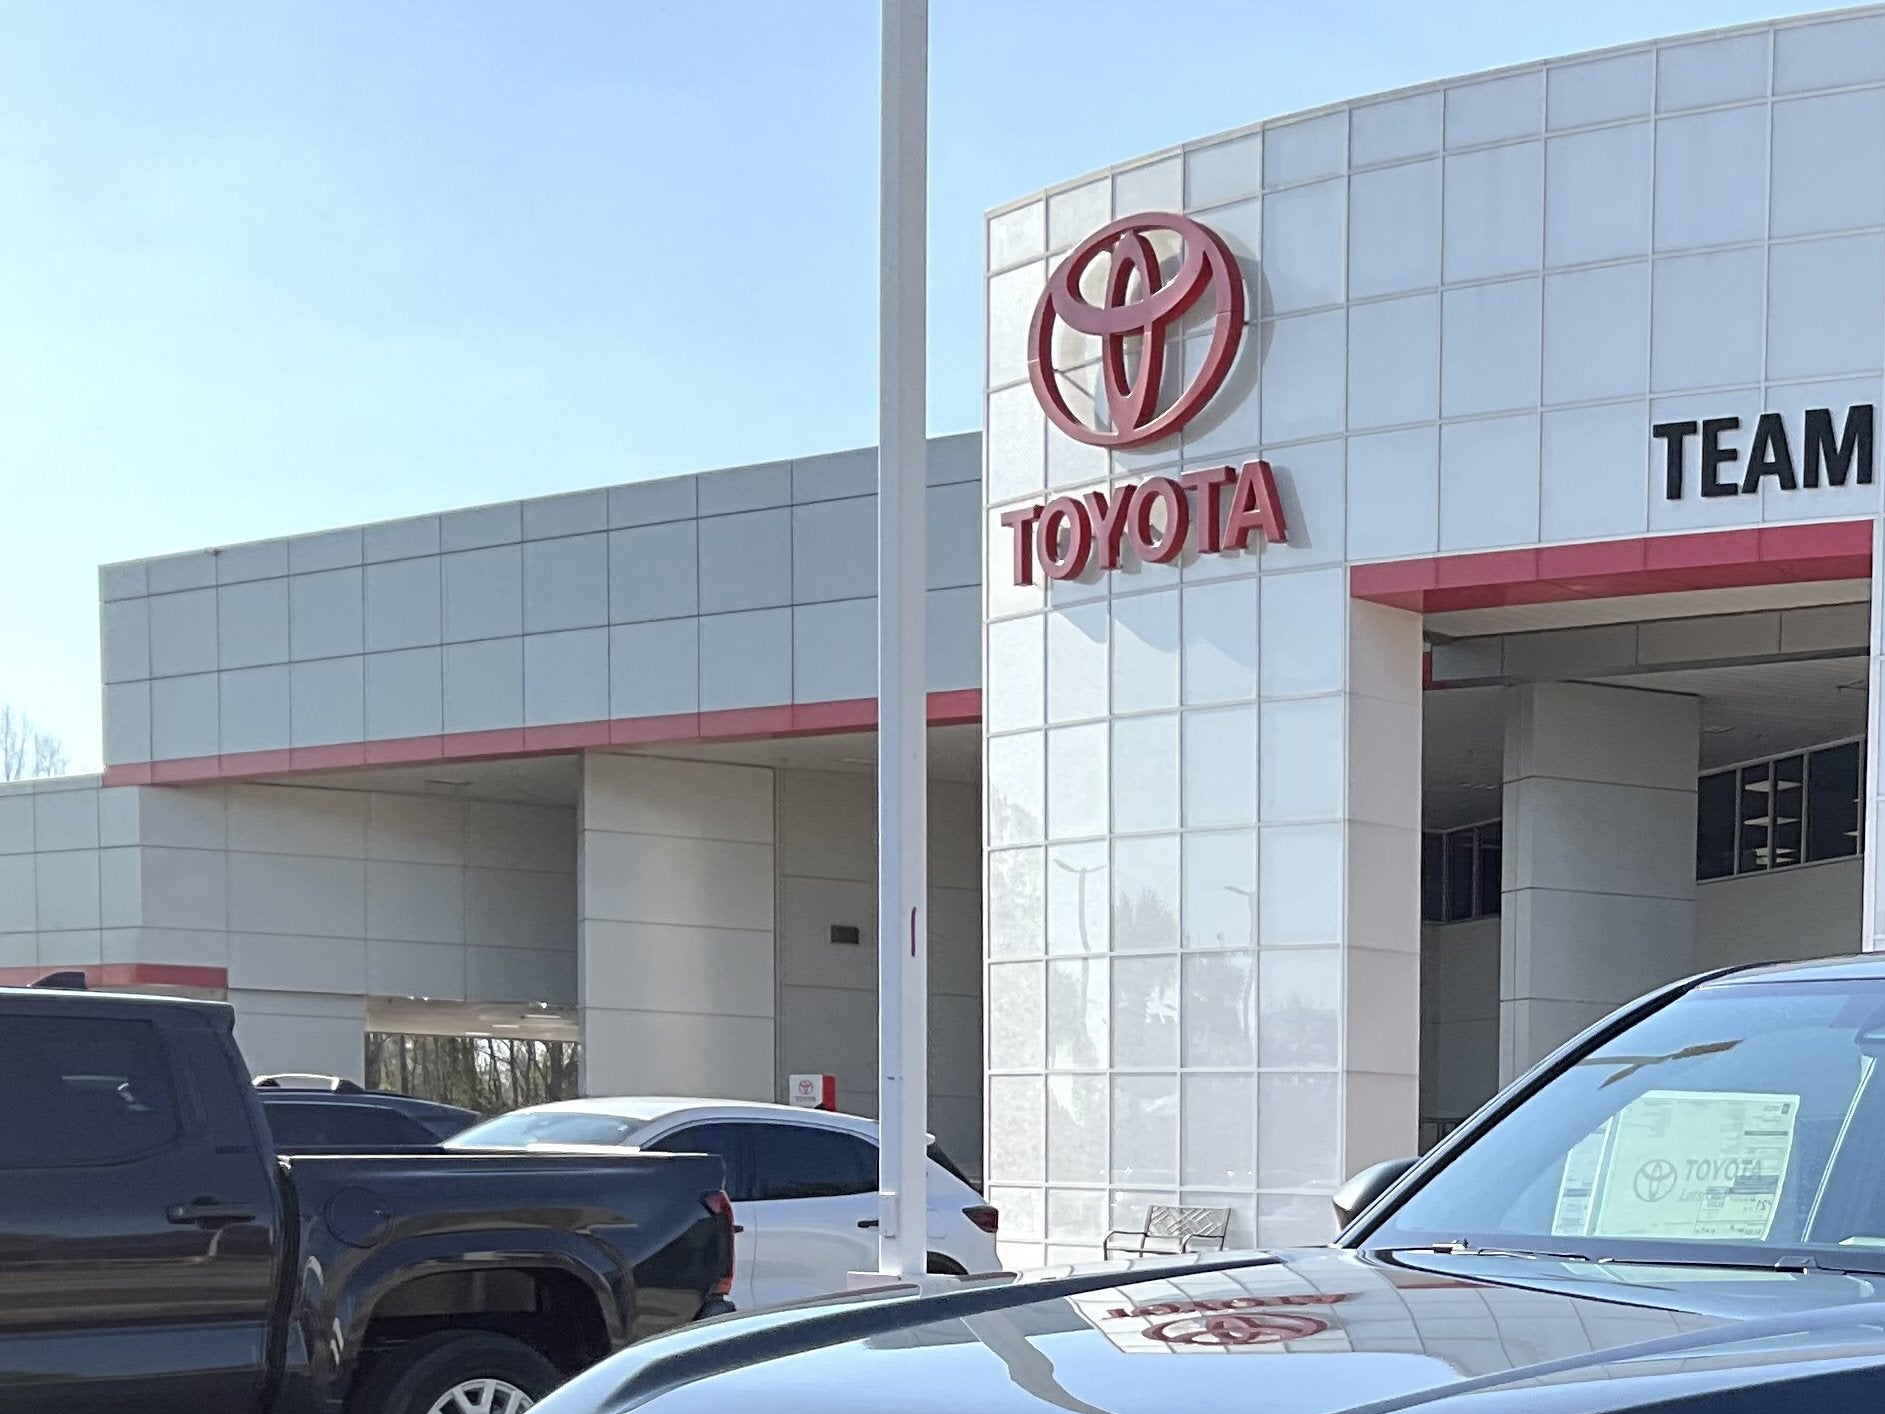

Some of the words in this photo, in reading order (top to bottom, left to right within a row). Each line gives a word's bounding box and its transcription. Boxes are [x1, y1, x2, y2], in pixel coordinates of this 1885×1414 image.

[1652, 403, 1874, 500] TEAM
[1001, 460, 1289, 587] TOYOTA
[1685, 1158, 1762, 1182] TOYOTA
